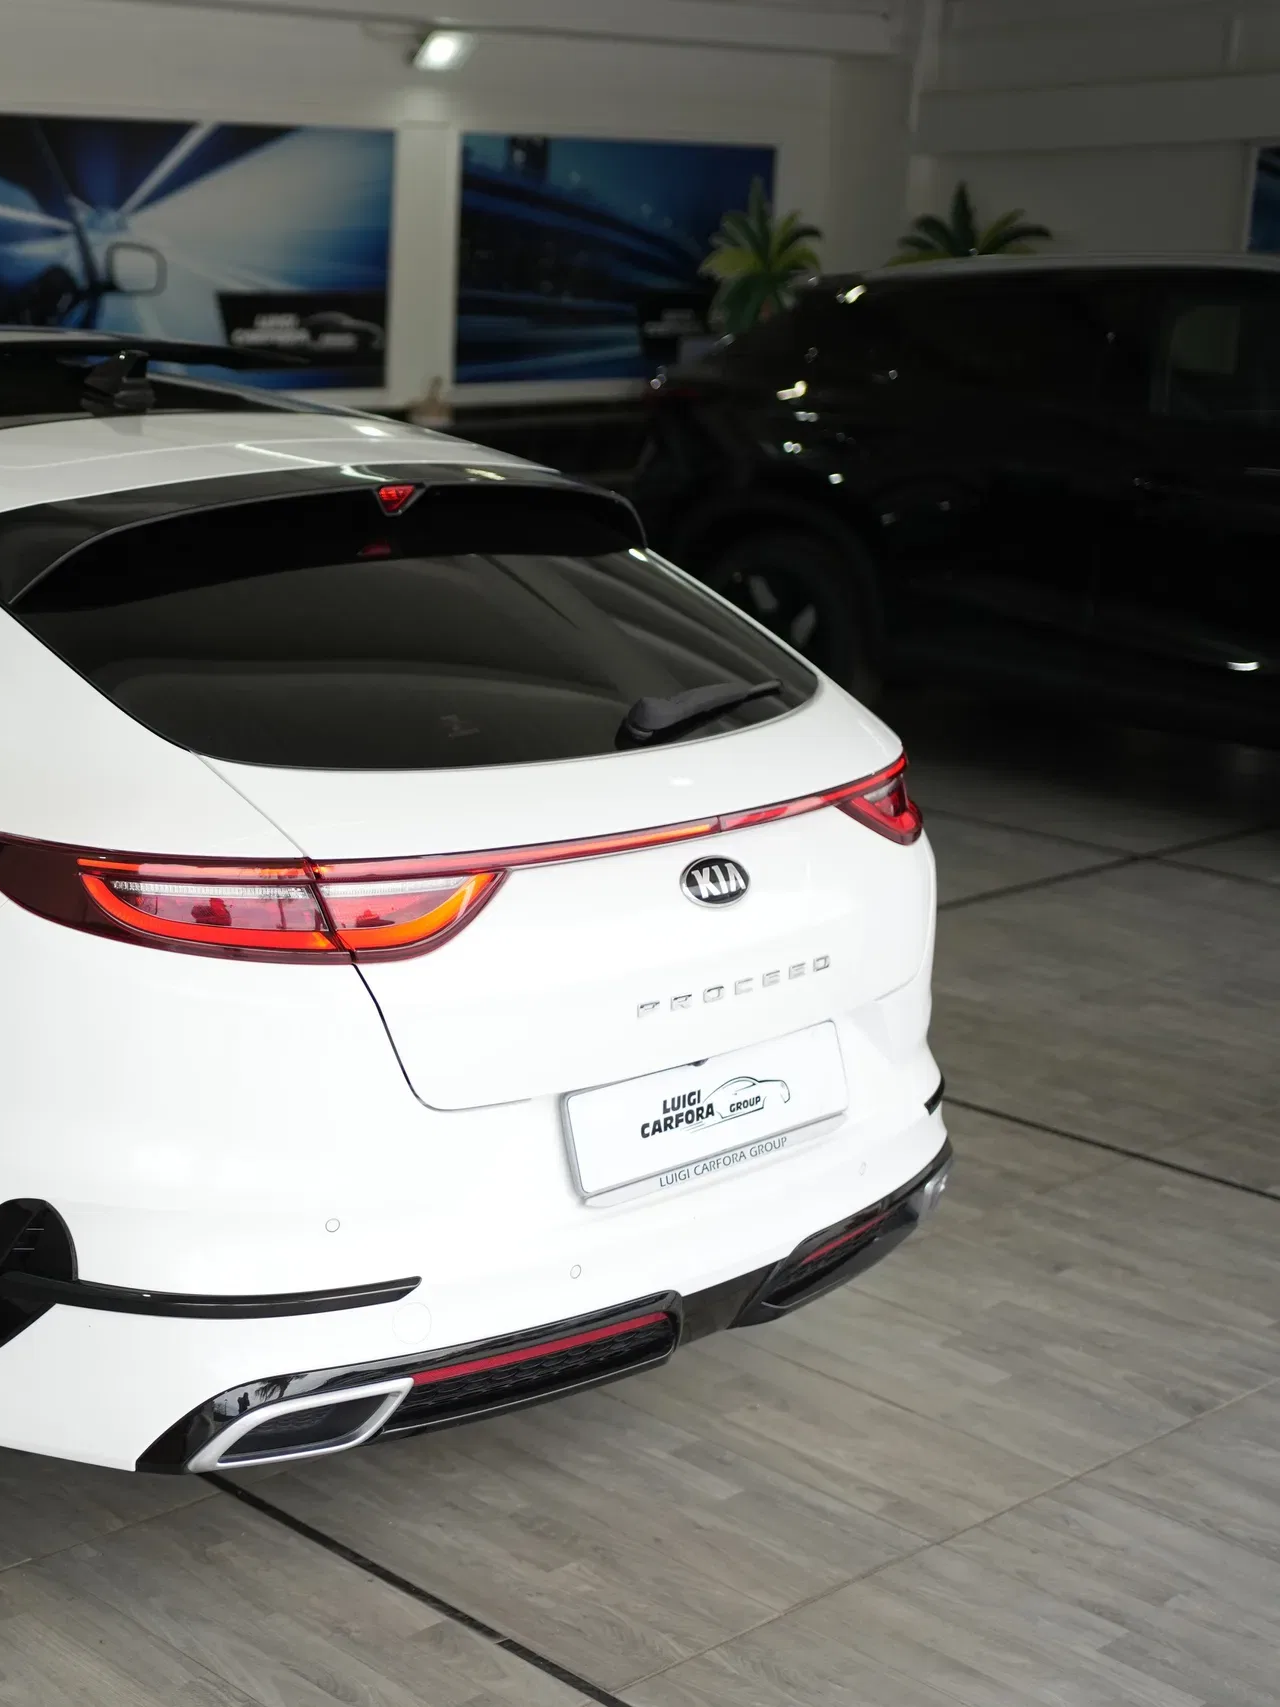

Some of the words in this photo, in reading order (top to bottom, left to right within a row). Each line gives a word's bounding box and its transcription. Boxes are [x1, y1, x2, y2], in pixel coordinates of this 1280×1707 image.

[691, 862, 746, 899] KIA
[637, 955, 830, 1018] PROCEED
[640, 1103, 715, 1138] CARFORA
[729, 1095, 761, 1113] GROUP
[662, 1089, 701, 1114] LUIGI
[659, 1168, 690, 1187] LUIGI
[693, 1151, 747, 1176] CARFORA
[749, 1136, 788, 1158] GROUP
